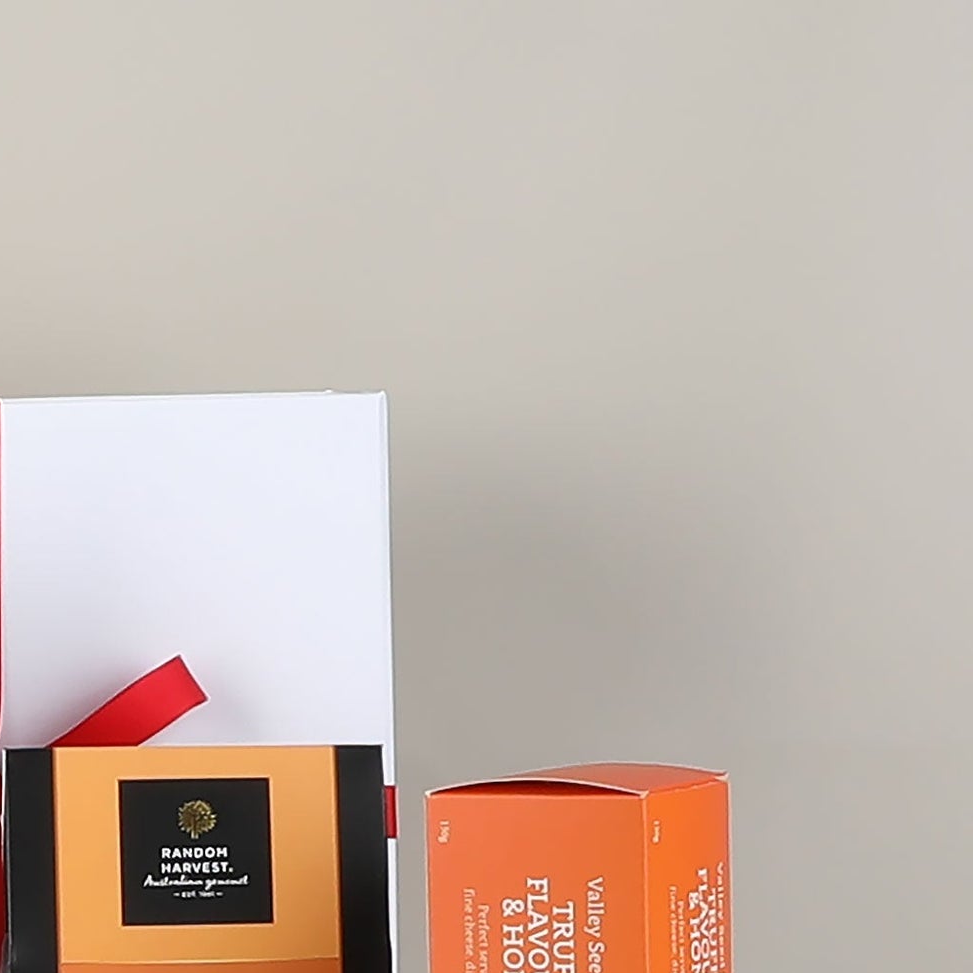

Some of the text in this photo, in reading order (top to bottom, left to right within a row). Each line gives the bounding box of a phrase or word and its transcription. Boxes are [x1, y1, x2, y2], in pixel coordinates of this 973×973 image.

[161, 846, 228, 859] RANDOM
[463, 888, 475, 913] fine
[501, 898, 525, 917] &
[584, 876, 605, 938] Valley
[477, 904, 490, 947] Perfect
